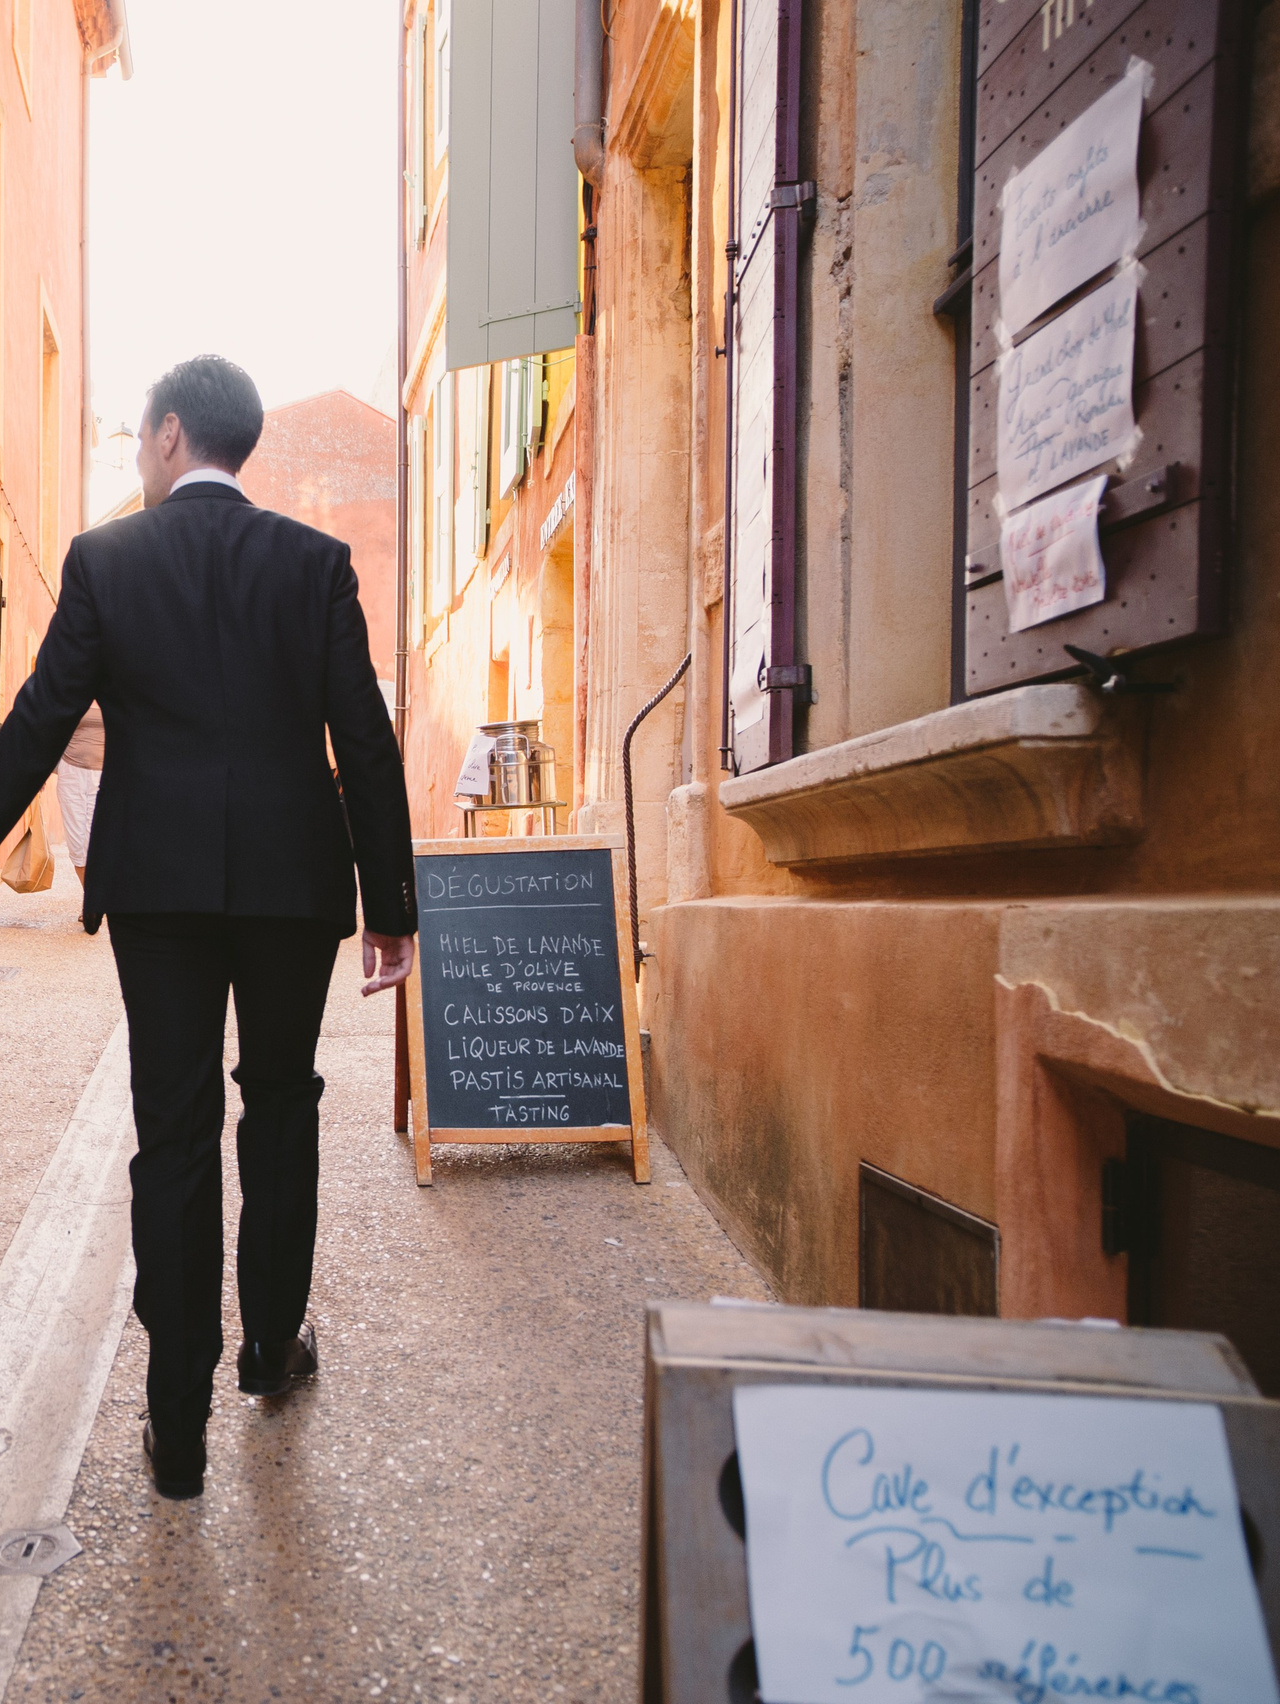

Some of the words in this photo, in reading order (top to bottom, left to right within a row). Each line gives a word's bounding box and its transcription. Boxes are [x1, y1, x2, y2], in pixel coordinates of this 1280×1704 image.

[439, 931, 487, 955] MIEL
[493, 935, 519, 956] DE
[528, 933, 605, 958] LAVANDE
[442, 959, 492, 980] HUILE
[500, 958, 580, 979] D'OLIVE
[487, 982, 502, 993] DE
[513, 981, 584, 993] PROVENCE
[444, 1003, 549, 1026] CALISSONS
[448, 1036, 531, 1060] LIQUEUR
[535, 1038, 555, 1055] DE
[563, 1036, 625, 1058] LAVANDE
[450, 1066, 525, 1091] PASTIS
[531, 1068, 624, 1090] ARTISANAL
[821, 1428, 933, 1521] Cave
[964, 1443, 1218, 1533] d'exception
[846, 1525, 984, 1605] Plus
[1023, 1555, 1075, 1608] de
[835, 1625, 948, 1686] 500
